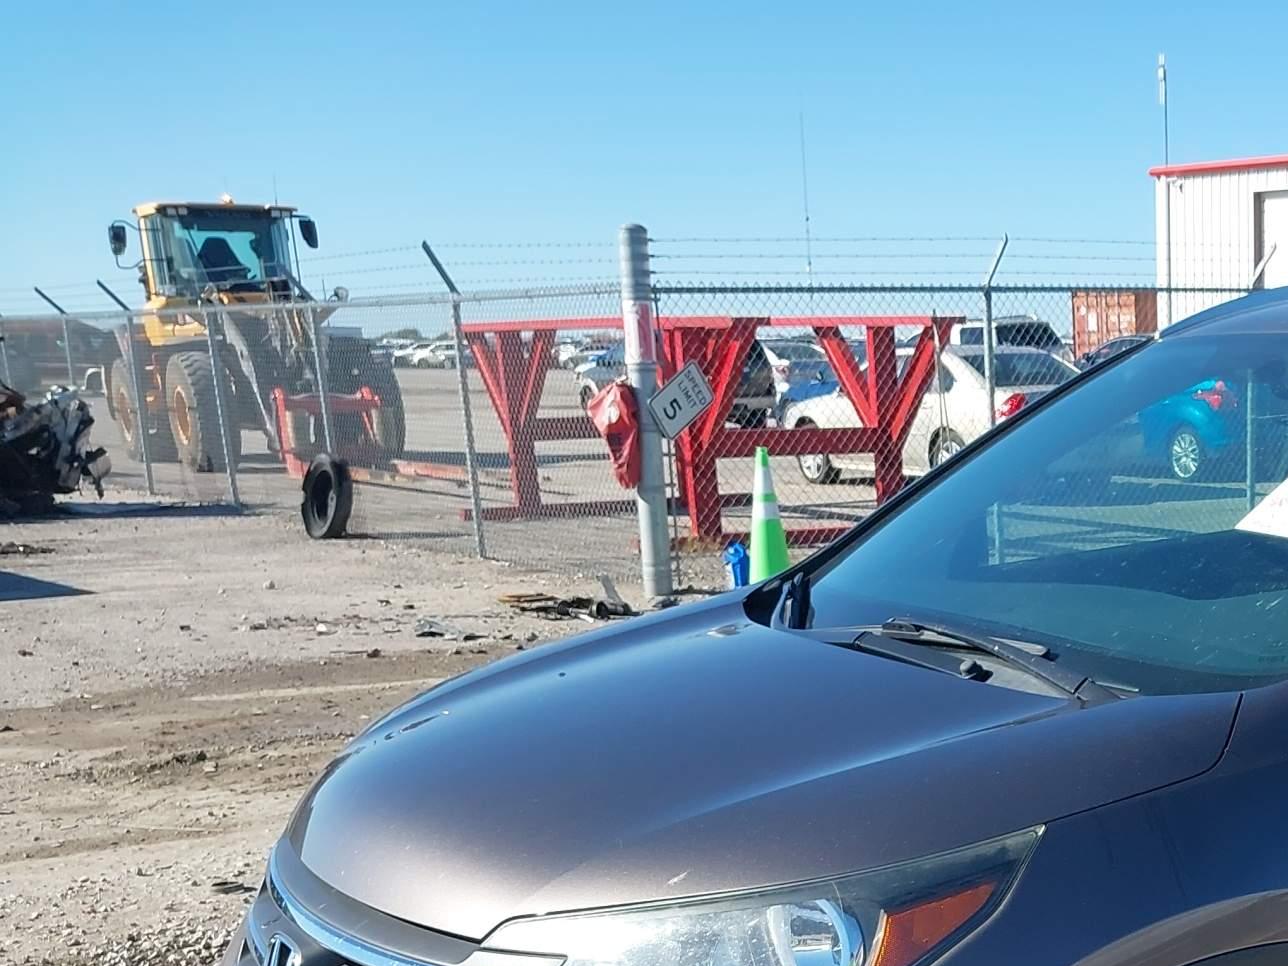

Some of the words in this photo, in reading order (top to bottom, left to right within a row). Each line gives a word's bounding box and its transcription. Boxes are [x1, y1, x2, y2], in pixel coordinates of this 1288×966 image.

[678, 380, 698, 409] LIMIT
[684, 369, 706, 405] SPEED
[663, 398, 682, 420] 5
